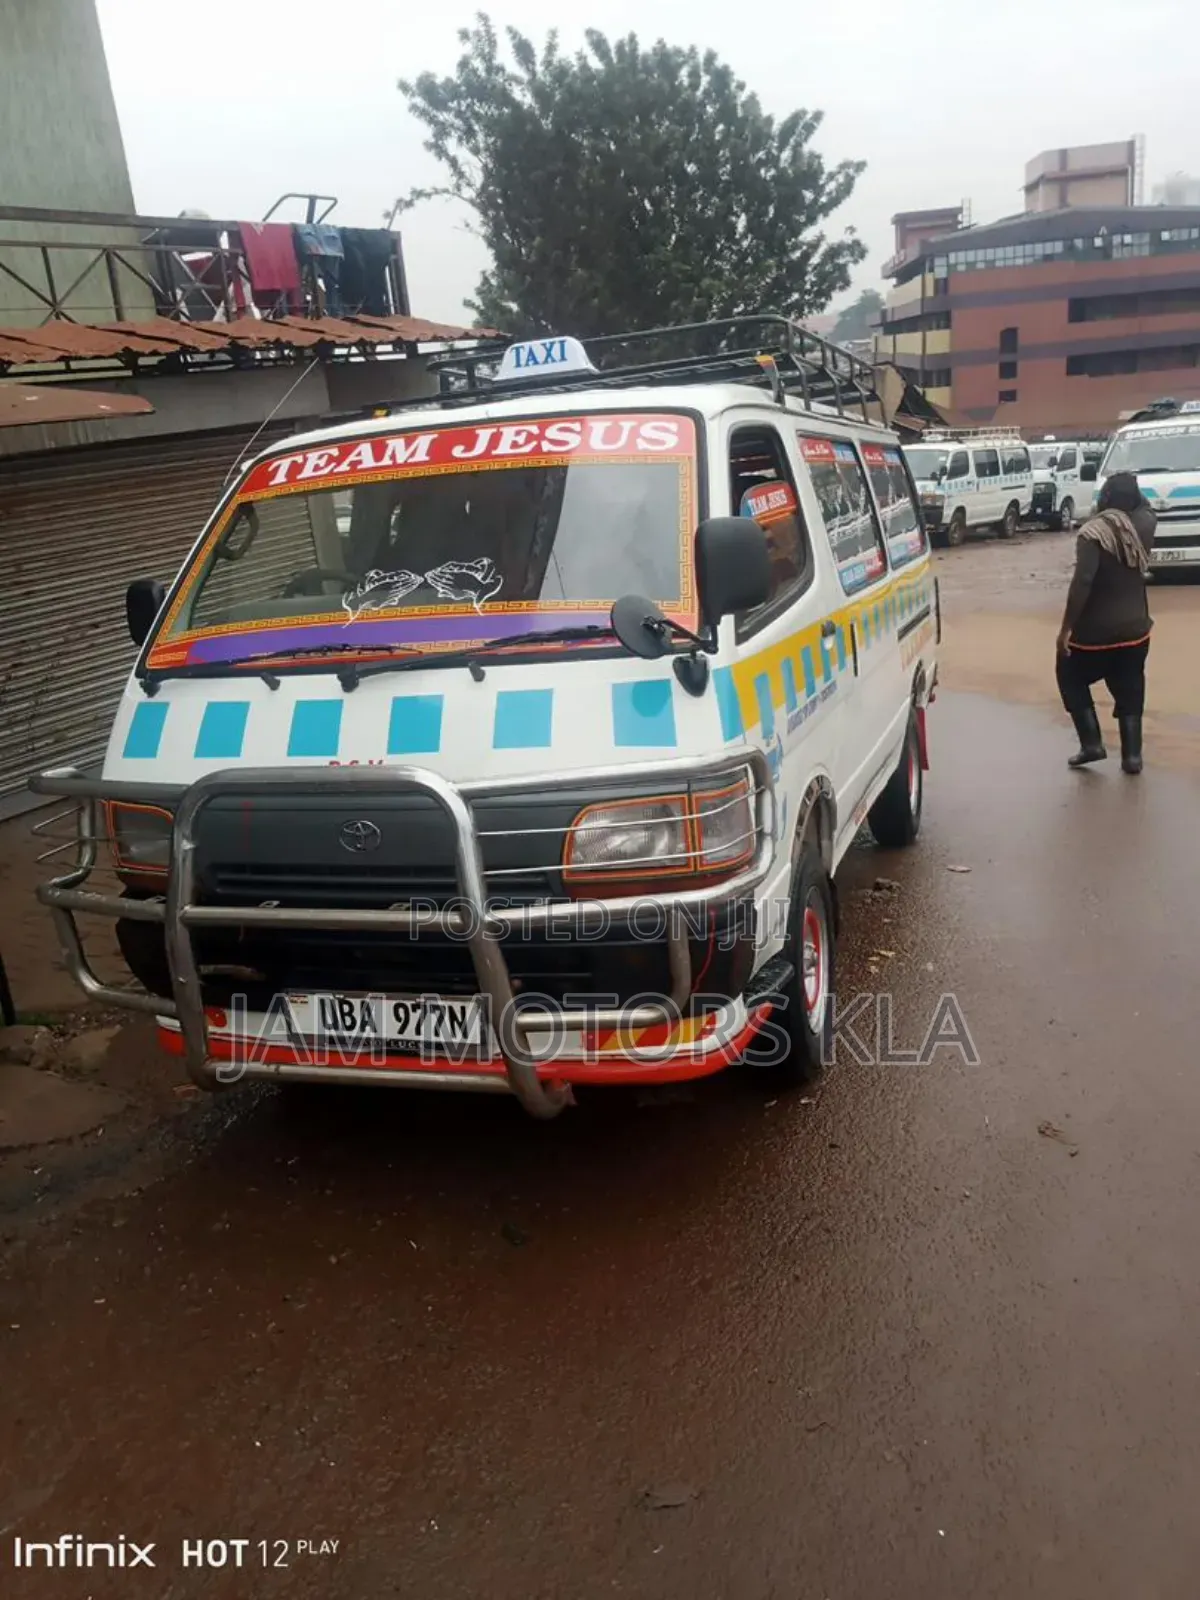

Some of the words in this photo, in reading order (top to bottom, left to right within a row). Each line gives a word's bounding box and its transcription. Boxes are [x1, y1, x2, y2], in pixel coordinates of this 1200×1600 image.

[511, 340, 568, 369] TAXI
[268, 434, 440, 485] TEAM
[451, 420, 680, 457] JESUS
[319, 997, 378, 1034] UBA
[393, 1003, 468, 1040] 977N
